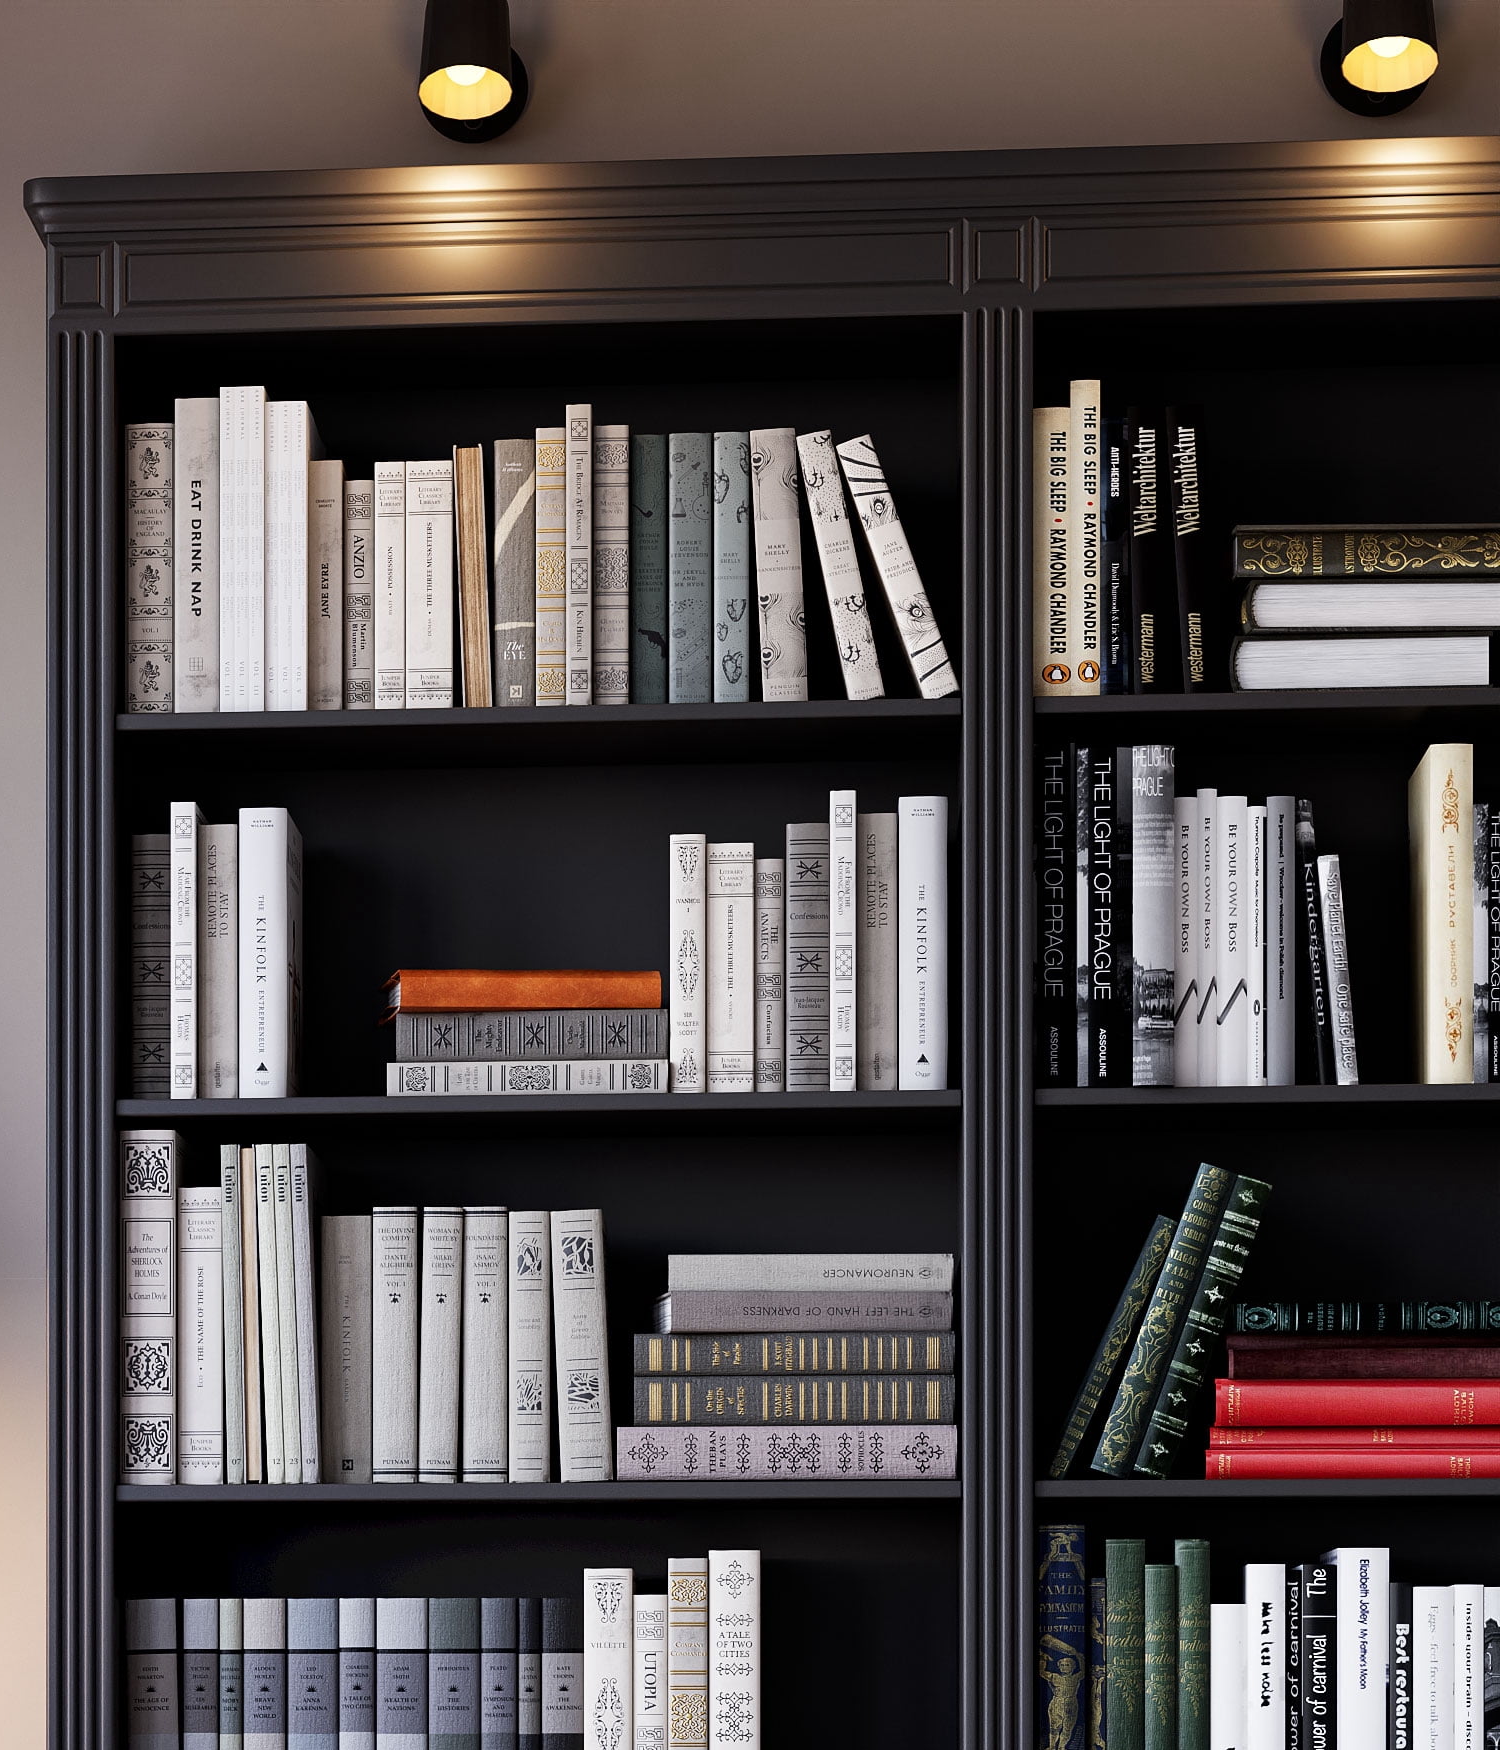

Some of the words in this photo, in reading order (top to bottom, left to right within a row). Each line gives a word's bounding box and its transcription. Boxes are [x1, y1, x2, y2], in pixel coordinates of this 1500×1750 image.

[1084, 406, 1096, 429] THE
[1050, 432, 1066, 452] THE
[1084, 433, 1096, 456] BIG
[1050, 457, 1066, 476] BIG
[1084, 461, 1096, 495] SLEEP
[1111, 447, 1119, 497] ANTI-HEROES
[1133, 427, 1156, 537] Weltarchitektur
[1173, 426, 1200, 537] Weltarchitektur
[191, 480, 202, 511] EAT
[1050, 480, 1066, 512] SLEEP
[191, 519, 202, 573] DRINK
[354, 535, 364, 579] ANZIO
[1050, 529, 1066, 588] RAYMOND
[1084, 513, 1096, 578] RAYMOND
[191, 581, 202, 617] NAP
[322, 590, 330, 618] JANE
[1084, 583, 1096, 650] CHANDLER
[1050, 593, 1066, 655] CHANDLER
[504, 651, 526, 660] EYE
[506, 642, 524, 650] The
[1140, 614, 1153, 683] westermann
[1188, 613, 1203, 682] westermann
[1094, 758, 1111, 801] THE
[1094, 807, 1111, 866] LIGHT
[1229, 824, 1237, 838] BE
[867, 834, 876, 876] PLACES
[1229, 841, 1237, 878] YOUR
[867, 881, 876, 928] REMOTE
[879, 881, 888, 908] STAY
[1094, 873, 1111, 903] OF
[1229, 882, 1237, 917] OWN
[790, 912, 828, 920] Confessions
[879, 913, 888, 928] TO
[917, 907, 927, 974] KINFOLK
[1094, 909, 1111, 1000] PRAGUE
[1304, 864, 1324, 1026] Kindergarten
[225, 1166, 235, 1203] Union
[260, 1166, 270, 1202] Union
[277, 1165, 287, 1202] Union
[295, 1165, 306, 1202] Union
[132, 1257, 163, 1266] SHERLOCK
[135, 1269, 159, 1278] HOLMES
[823, 1268, 914, 1278] NEUROMANCER
[197, 1307, 204, 1317] OF
[744, 1306, 799, 1316] DARKNESS
[806, 1306, 821, 1316] OF
[828, 1306, 859, 1316] HAND
[865, 1306, 889, 1316] LEFT
[895, 1306, 914, 1316] THE
[1261, 1602, 1272, 1634] Make
[1261, 1642, 1274, 1665] less
[1396, 1624, 1409, 1664] Best
[1306, 1634, 1326, 1694] carnival
[644, 1653, 657, 1711] UTOPIA
[1261, 1672, 1270, 1708] noise
[1306, 1697, 1326, 1715] of
